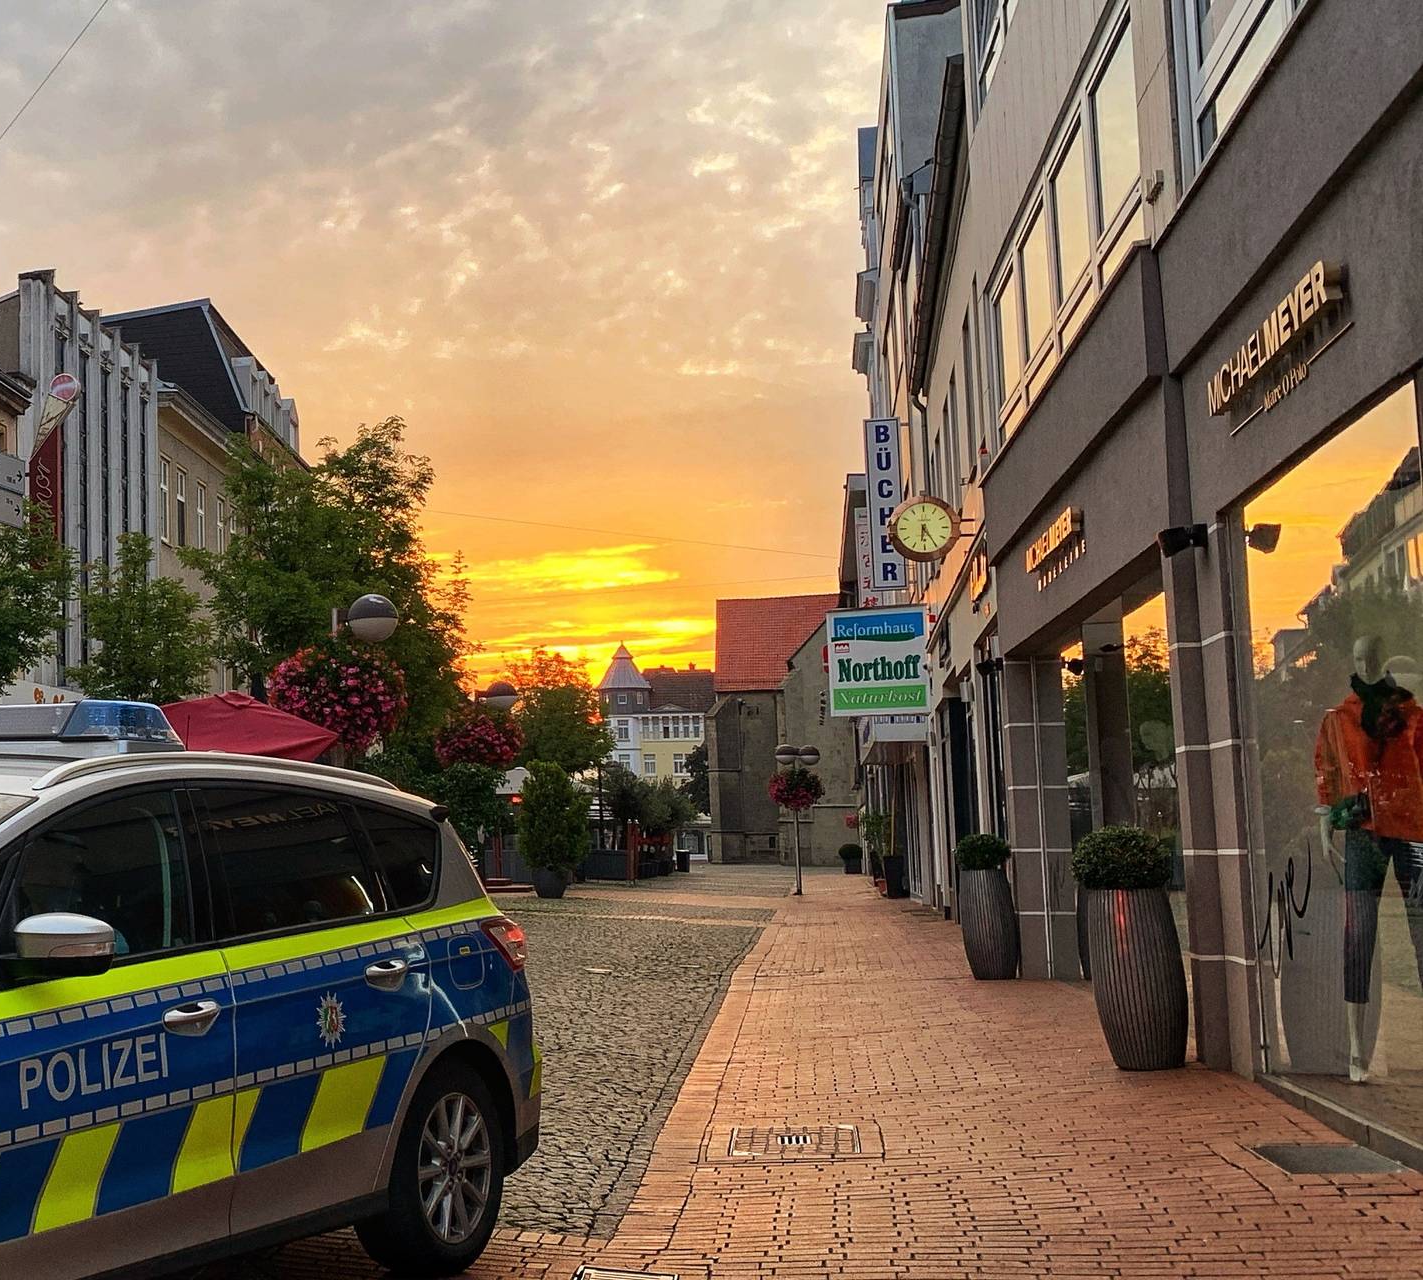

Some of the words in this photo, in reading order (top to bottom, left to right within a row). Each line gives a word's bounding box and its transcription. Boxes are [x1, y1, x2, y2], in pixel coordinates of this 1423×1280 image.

[875, 424, 898, 582] BÜCHER
[837, 622, 915, 642] Reformhaus
[838, 655, 921, 682] Northoff
[838, 690, 922, 704] Naturkost
[19, 1032, 169, 1110] POLIZEI
